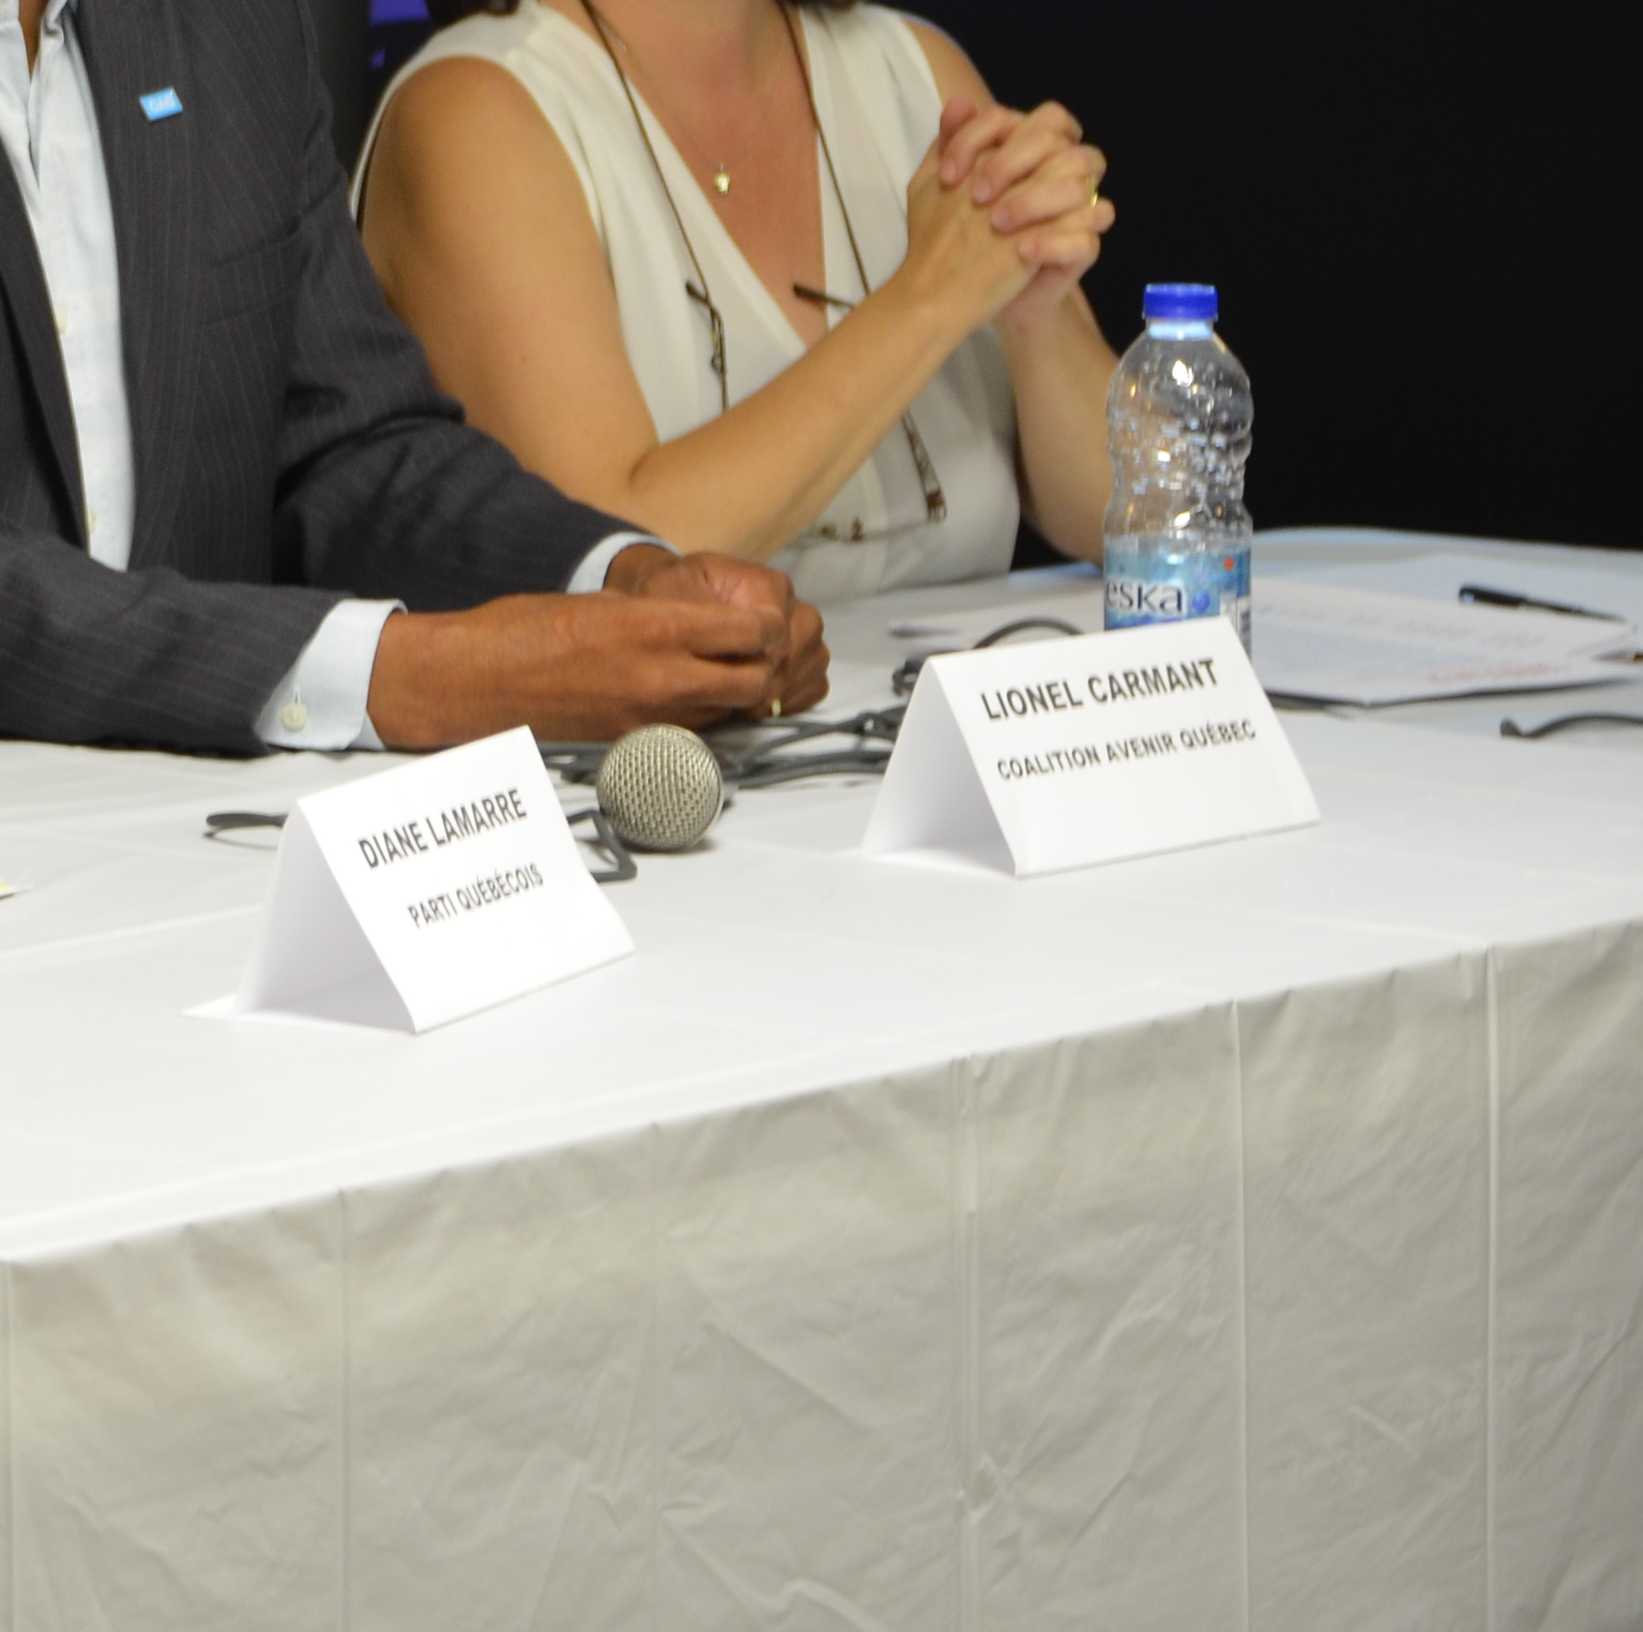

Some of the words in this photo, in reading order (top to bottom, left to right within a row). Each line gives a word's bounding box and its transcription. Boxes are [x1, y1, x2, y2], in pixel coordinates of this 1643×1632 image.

[1106, 582, 1182, 613] eska
[980, 681, 1084, 720] LIONEL
[1087, 658, 1217, 703] CARMANT
[997, 746, 1101, 780] COALITION
[1106, 734, 1174, 762] AVENIR
[1179, 720, 1256, 749] QUÉBEC
[358, 822, 429, 869] DIANE
[426, 788, 527, 846] LAMARRE
[407, 893, 457, 927] PARTI
[456, 863, 544, 911] QUÉBÉCOIS
